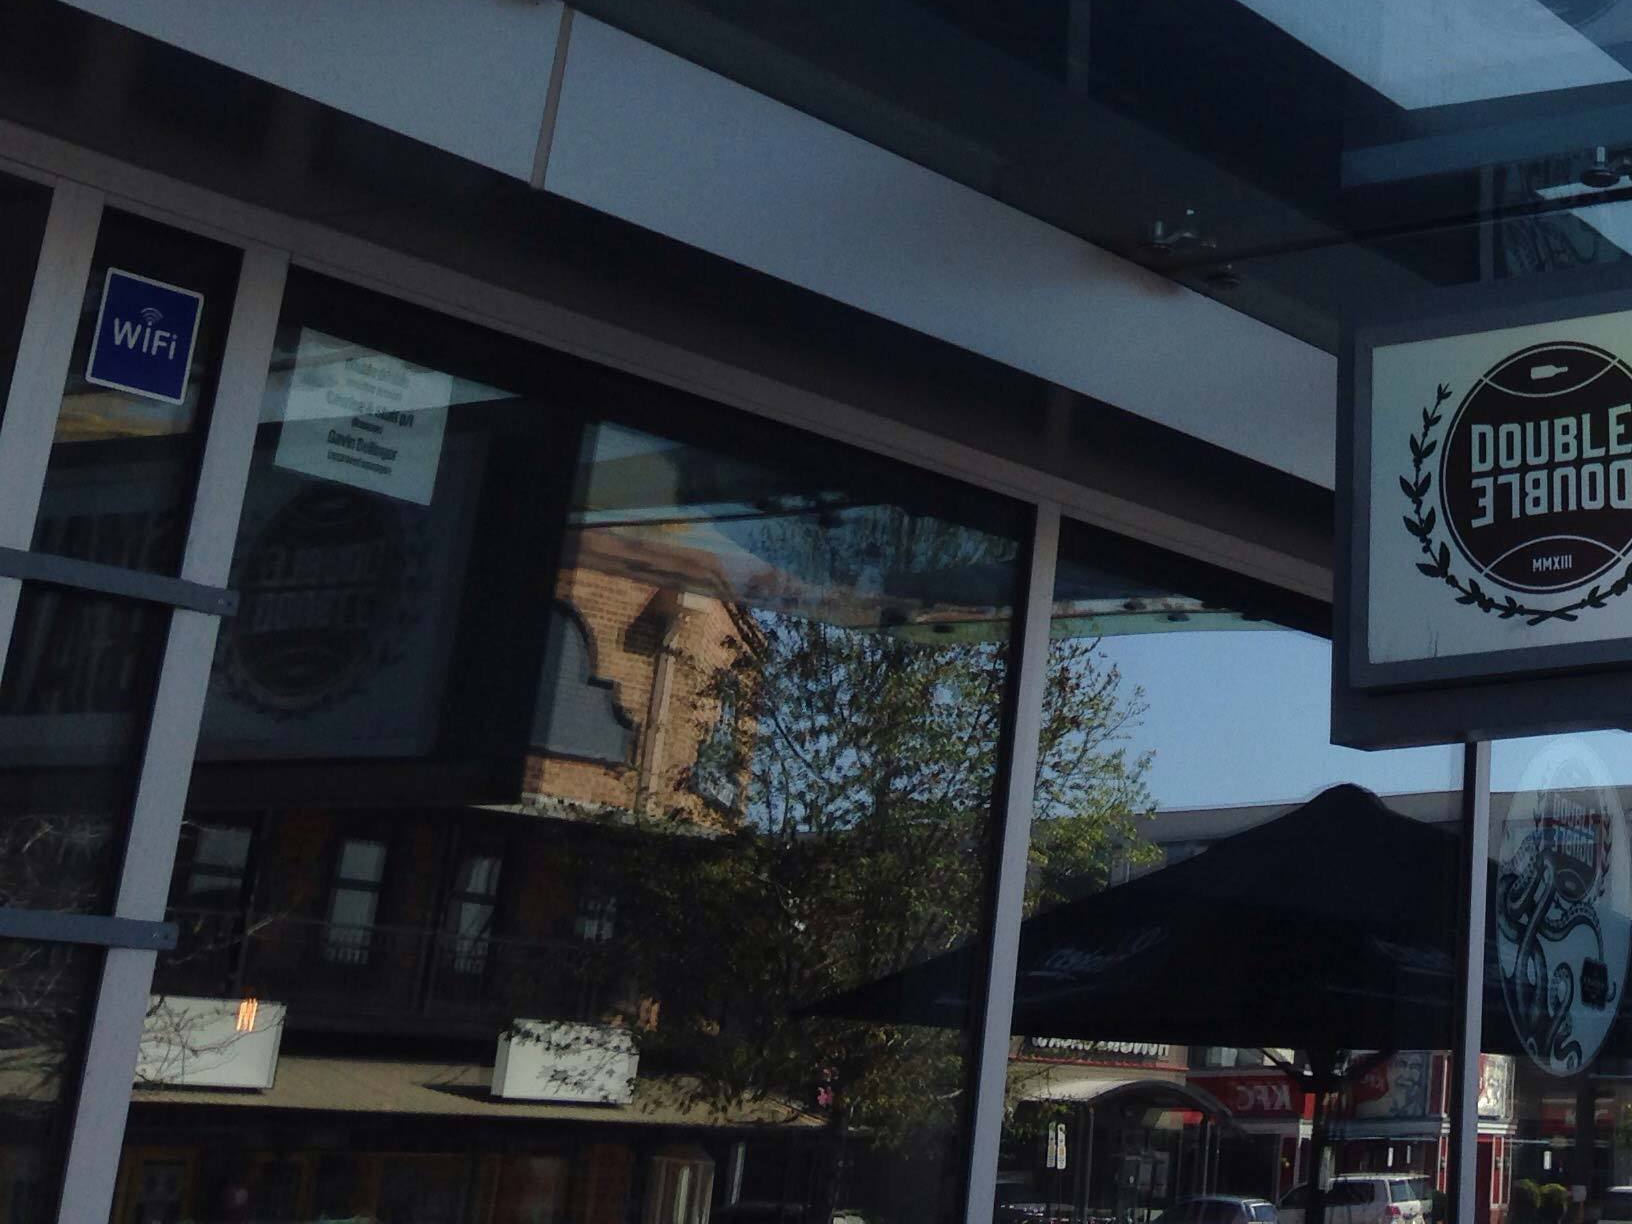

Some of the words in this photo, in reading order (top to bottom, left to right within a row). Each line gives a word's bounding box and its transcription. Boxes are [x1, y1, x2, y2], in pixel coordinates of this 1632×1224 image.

[114, 317, 177, 361] WiFi
[1471, 403, 1632, 473] DOUBLE
[1532, 554, 1573, 573] MMXIII
